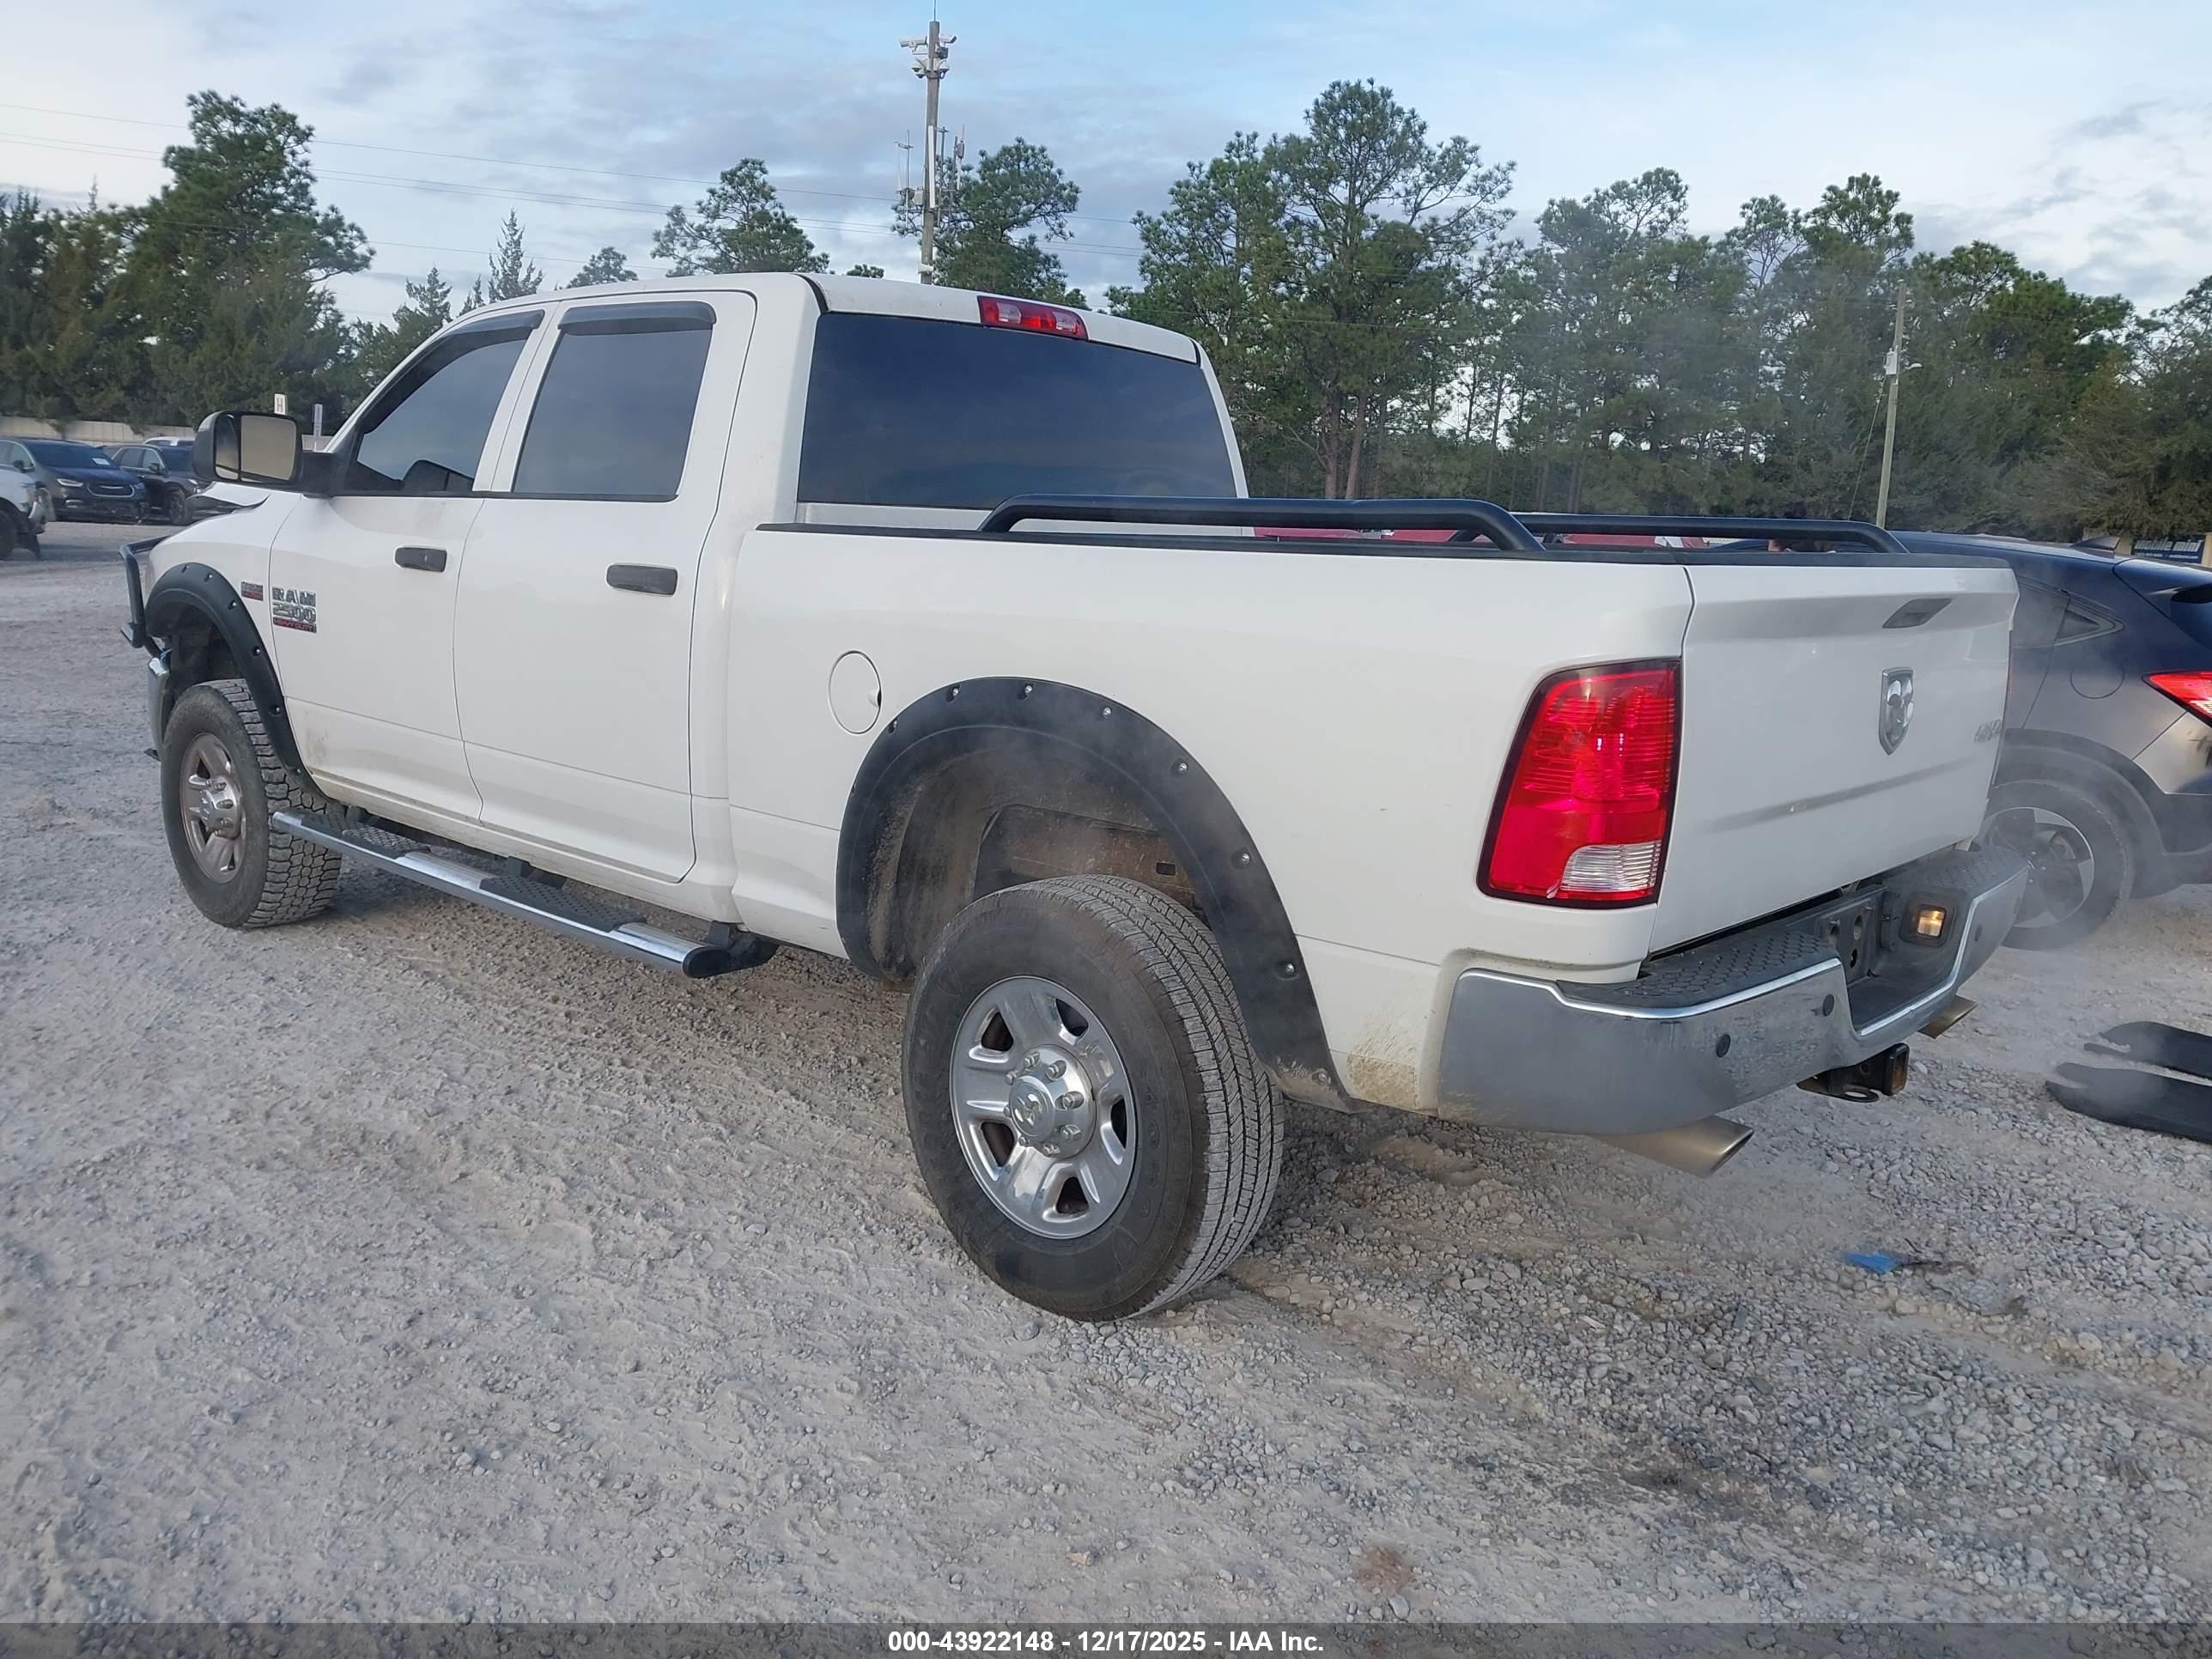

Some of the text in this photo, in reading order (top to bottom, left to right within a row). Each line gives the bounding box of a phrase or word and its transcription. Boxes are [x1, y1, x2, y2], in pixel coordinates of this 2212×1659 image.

[2134, 537, 2203, 552] mobile mini
[272, 586, 316, 606] RAM
[272, 602, 316, 623] 2500
